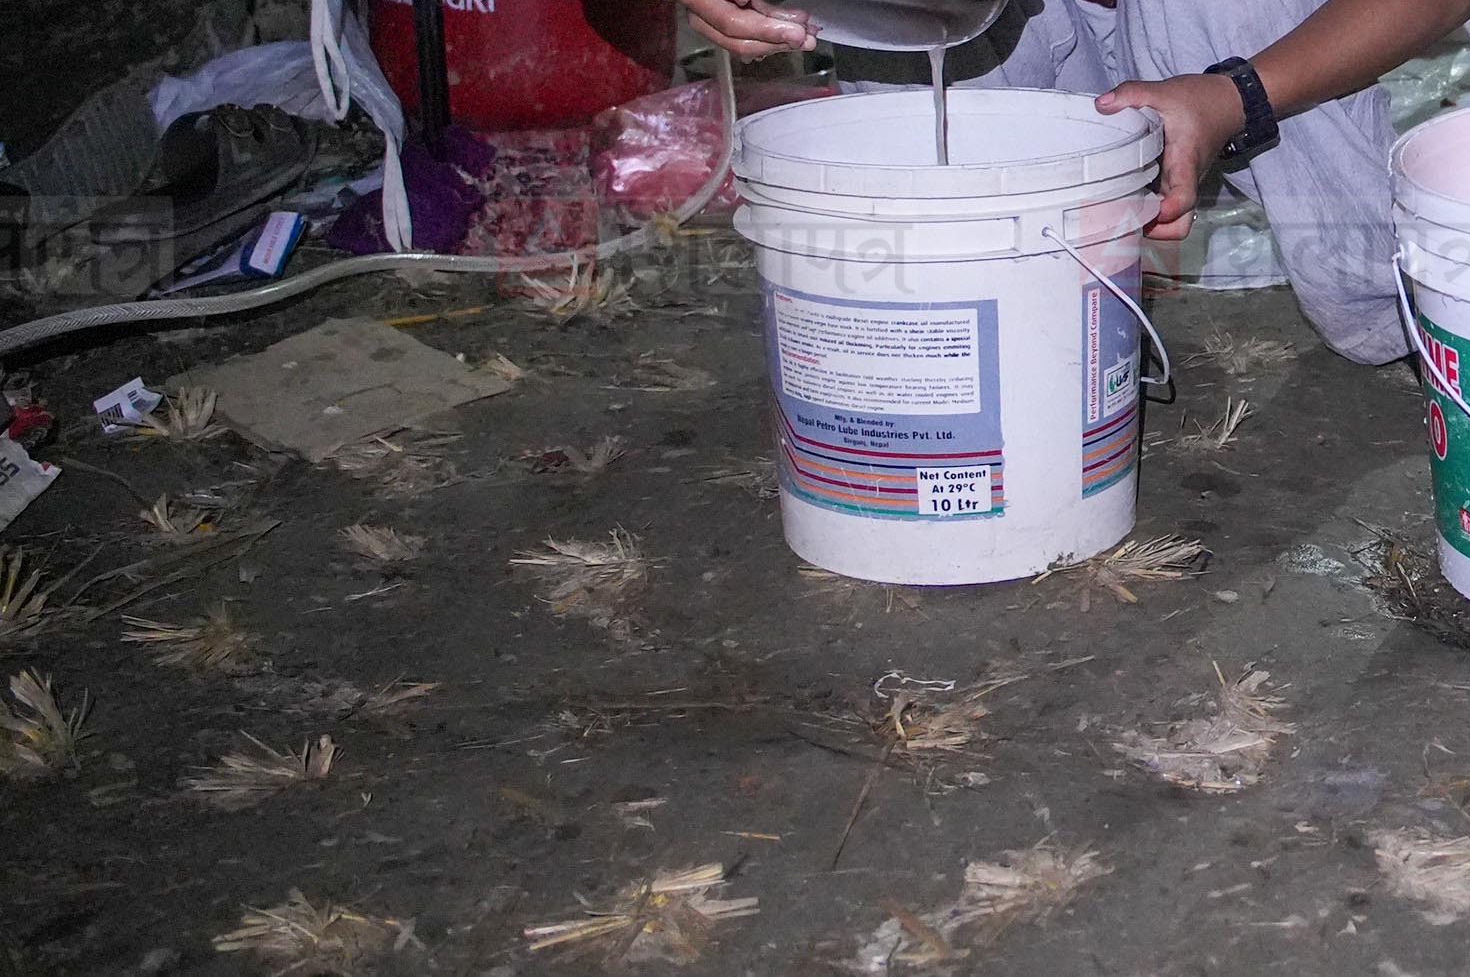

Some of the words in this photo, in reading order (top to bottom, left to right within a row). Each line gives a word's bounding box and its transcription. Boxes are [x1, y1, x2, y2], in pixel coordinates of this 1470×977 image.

[1091, 292, 1099, 330] Compare
[1090, 331, 1099, 366] Beyond
[1090, 366, 1098, 421] Performance
[816, 419, 836, 432] Petro
[838, 424, 858, 436] Lube
[861, 427, 910, 440] Industries
[912, 431, 932, 440] Pvt.
[936, 430, 956, 440] Ltd.
[856, 418, 883, 427] Blended
[920, 471, 939, 480] Net
[944, 470, 986, 480] Content
[932, 484, 944, 494] At
[948, 482, 976, 493] 29°C
[932, 498, 952, 512] 10
[958, 498, 979, 511] Ltr
